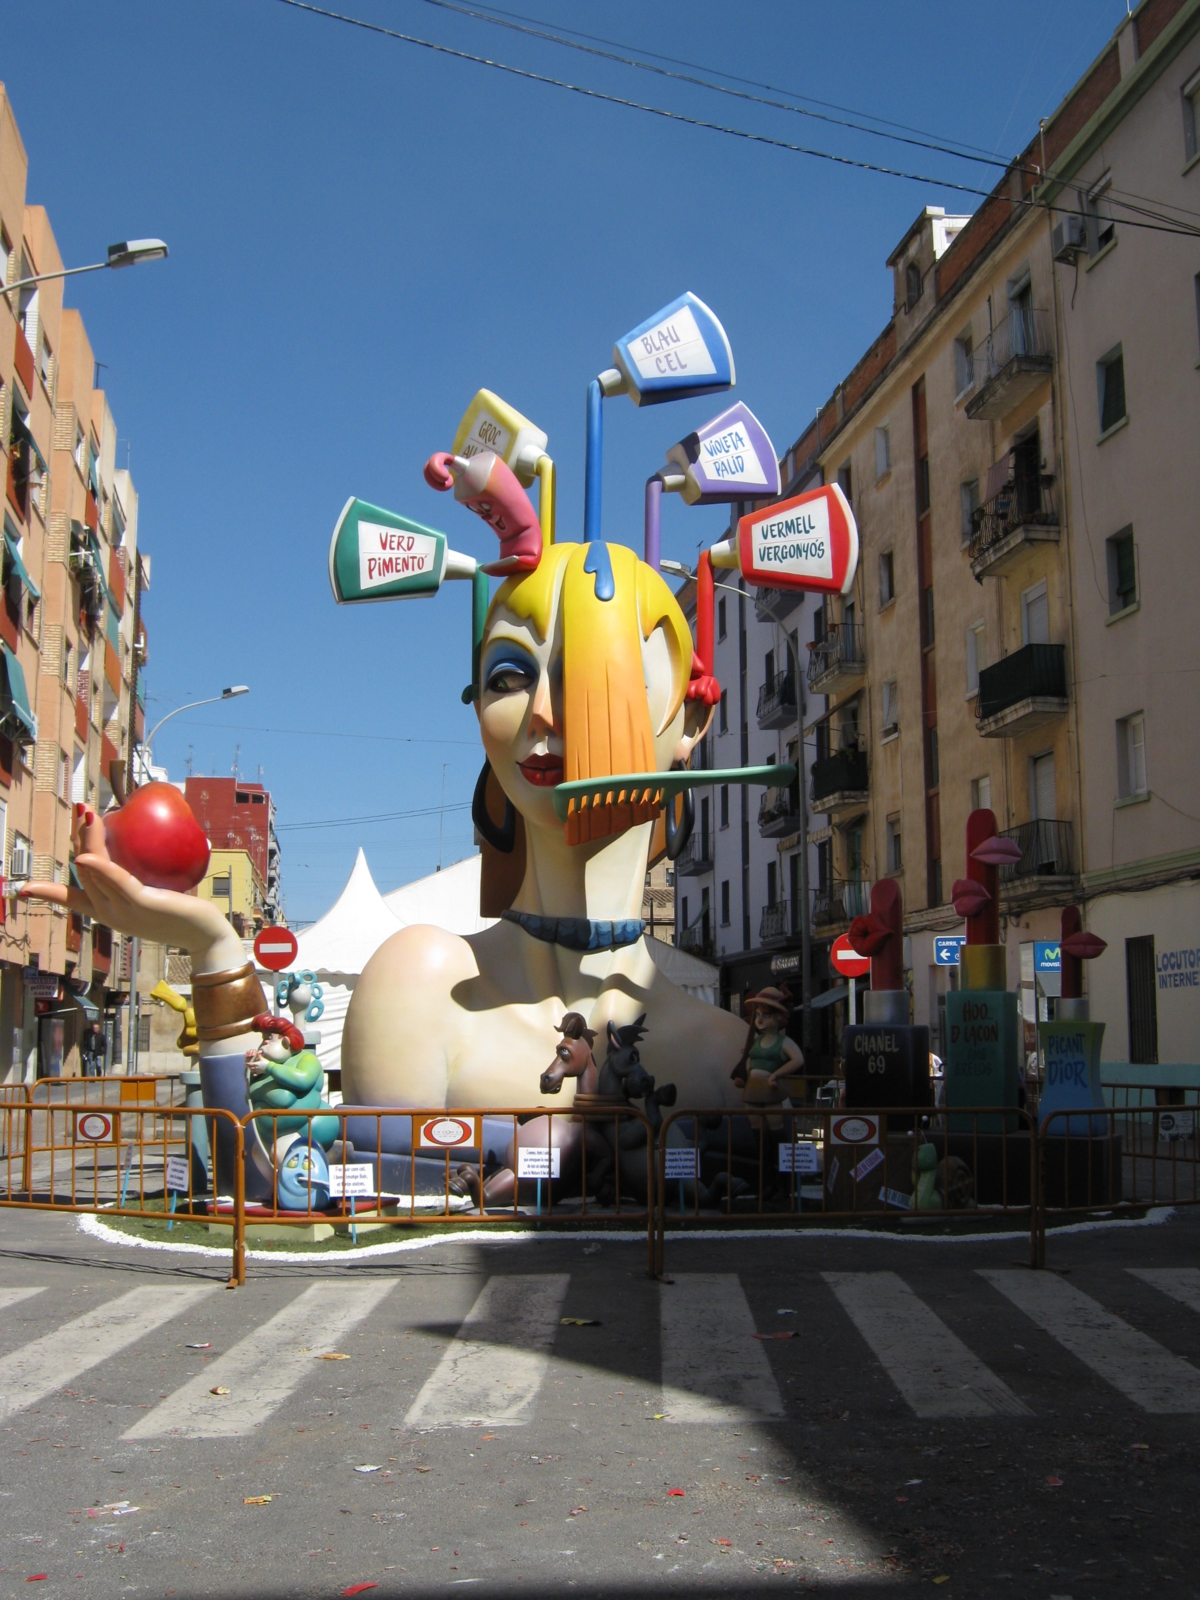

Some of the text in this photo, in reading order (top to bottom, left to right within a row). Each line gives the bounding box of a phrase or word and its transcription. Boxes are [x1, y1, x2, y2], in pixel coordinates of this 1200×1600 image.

[640, 324, 681, 355] BLAU
[655, 351, 687, 374] CEL
[478, 420, 501, 446] GROC
[703, 431, 745, 457] VIOLETA
[713, 455, 744, 478] PALID
[761, 514, 816, 540] VERMELL
[379, 531, 415, 552] VERD
[758, 538, 825, 564] VERGONYÓS
[854, 1028, 900, 1055] CHANEL
[1047, 1033, 1086, 1059] PICANT
[867, 1055, 886, 1075] 69
[1048, 1059, 1088, 1089] DIOR
